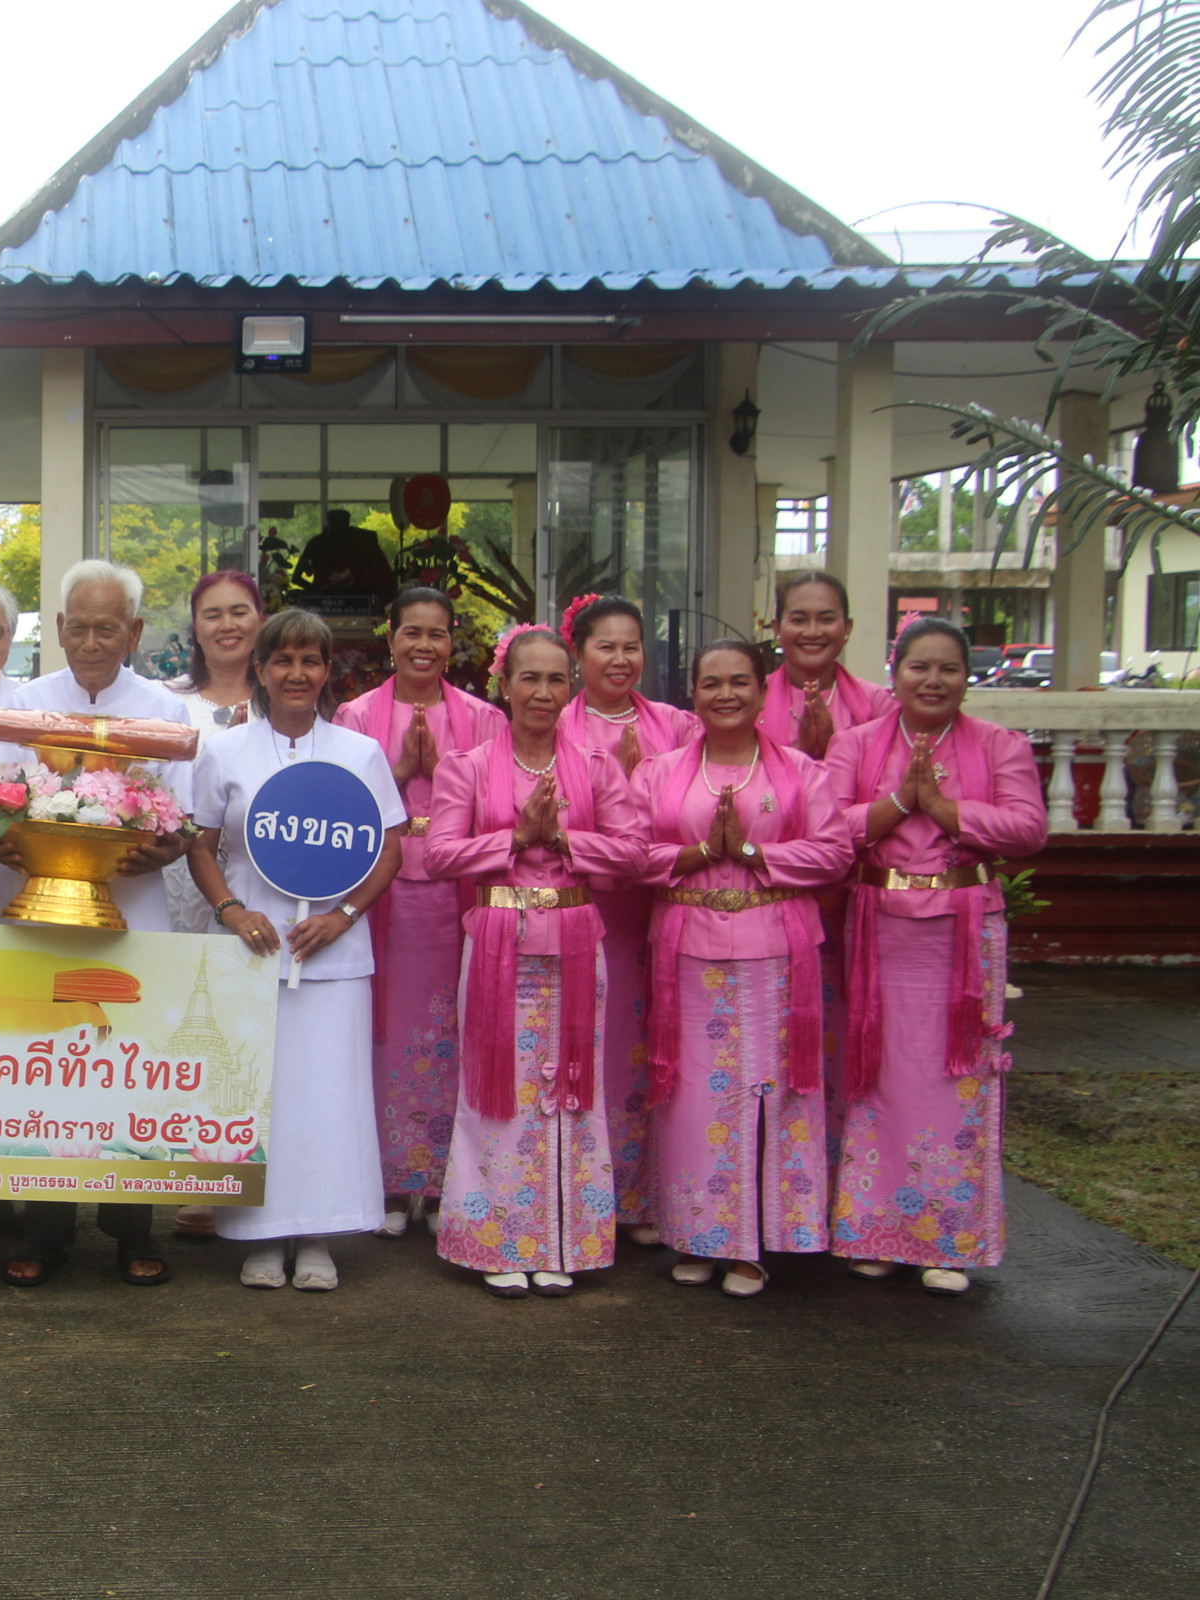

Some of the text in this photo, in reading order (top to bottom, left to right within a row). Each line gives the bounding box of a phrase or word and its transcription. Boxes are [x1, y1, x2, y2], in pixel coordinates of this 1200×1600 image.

[254, 810, 376, 853] สงขลา
[127, 1111, 255, 1146] ๒๕๖๘
[8, 1174, 78, 1193] บูชาธรรม
[121, 1171, 242, 1193] หลวงพ่อธัมมชโย
